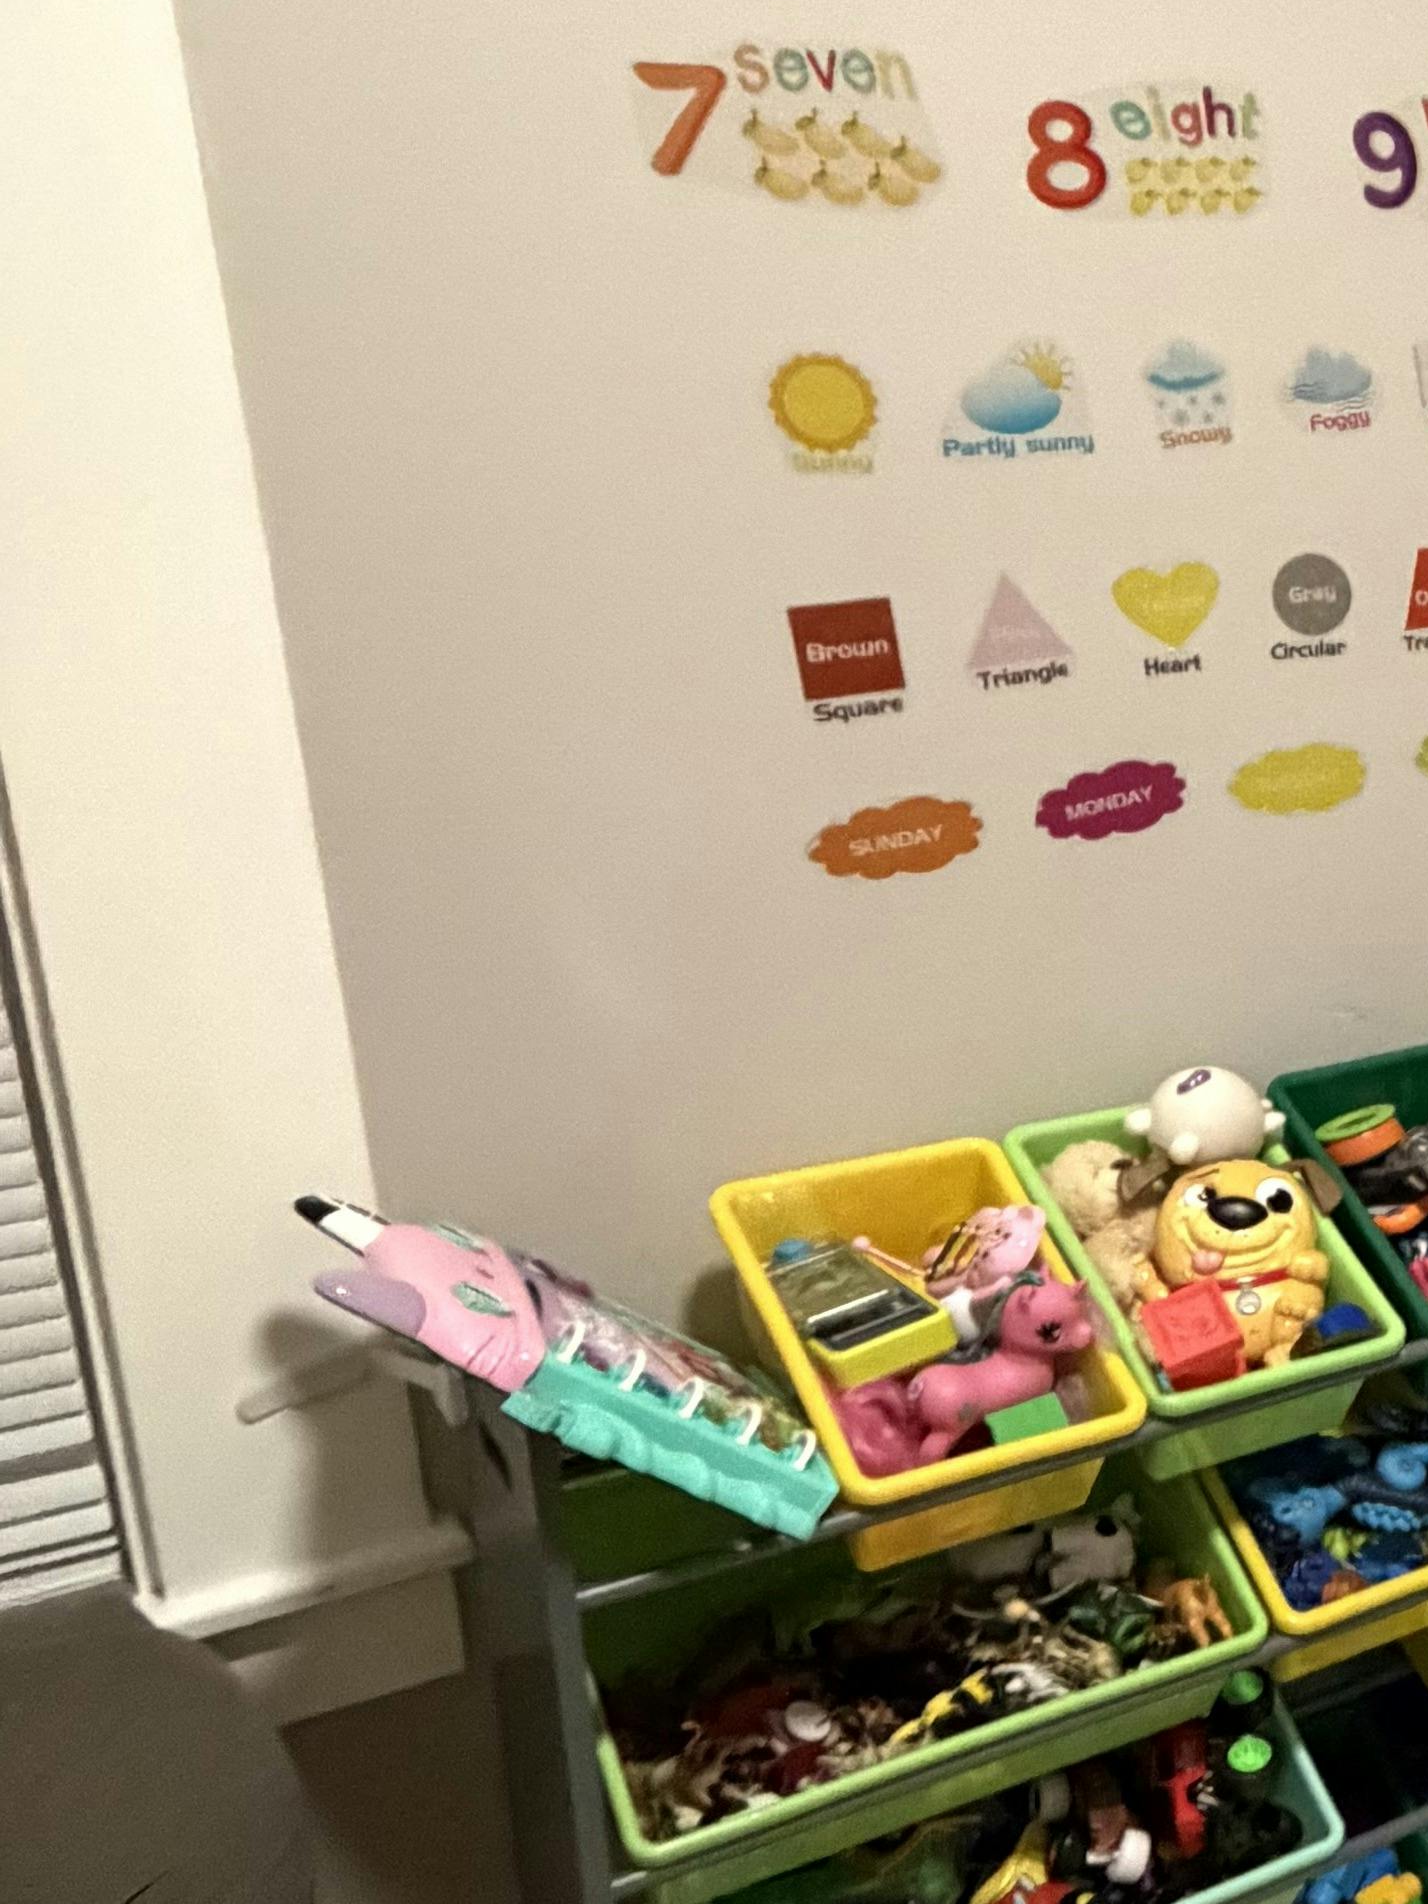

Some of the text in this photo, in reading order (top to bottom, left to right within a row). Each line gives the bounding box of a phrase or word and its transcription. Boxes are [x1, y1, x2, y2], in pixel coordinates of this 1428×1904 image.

[633, 43, 917, 176] 7 seven
[1026, 86, 1260, 210] 8 eight
[1353, 111, 1418, 210] 9
[1309, 409, 1372, 433] Foggy
[942, 433, 1096, 459] Partly sunny
[1159, 424, 1234, 450] Snowy
[805, 638, 890, 664] Brown
[1270, 639, 1347, 659] Circular
[975, 660, 1070, 691] Triangle
[1143, 653, 1202, 676] Heart
[812, 696, 904, 724] Square
[1063, 784, 1154, 823] MONDAY
[848, 823, 944, 857] SUNDAY
